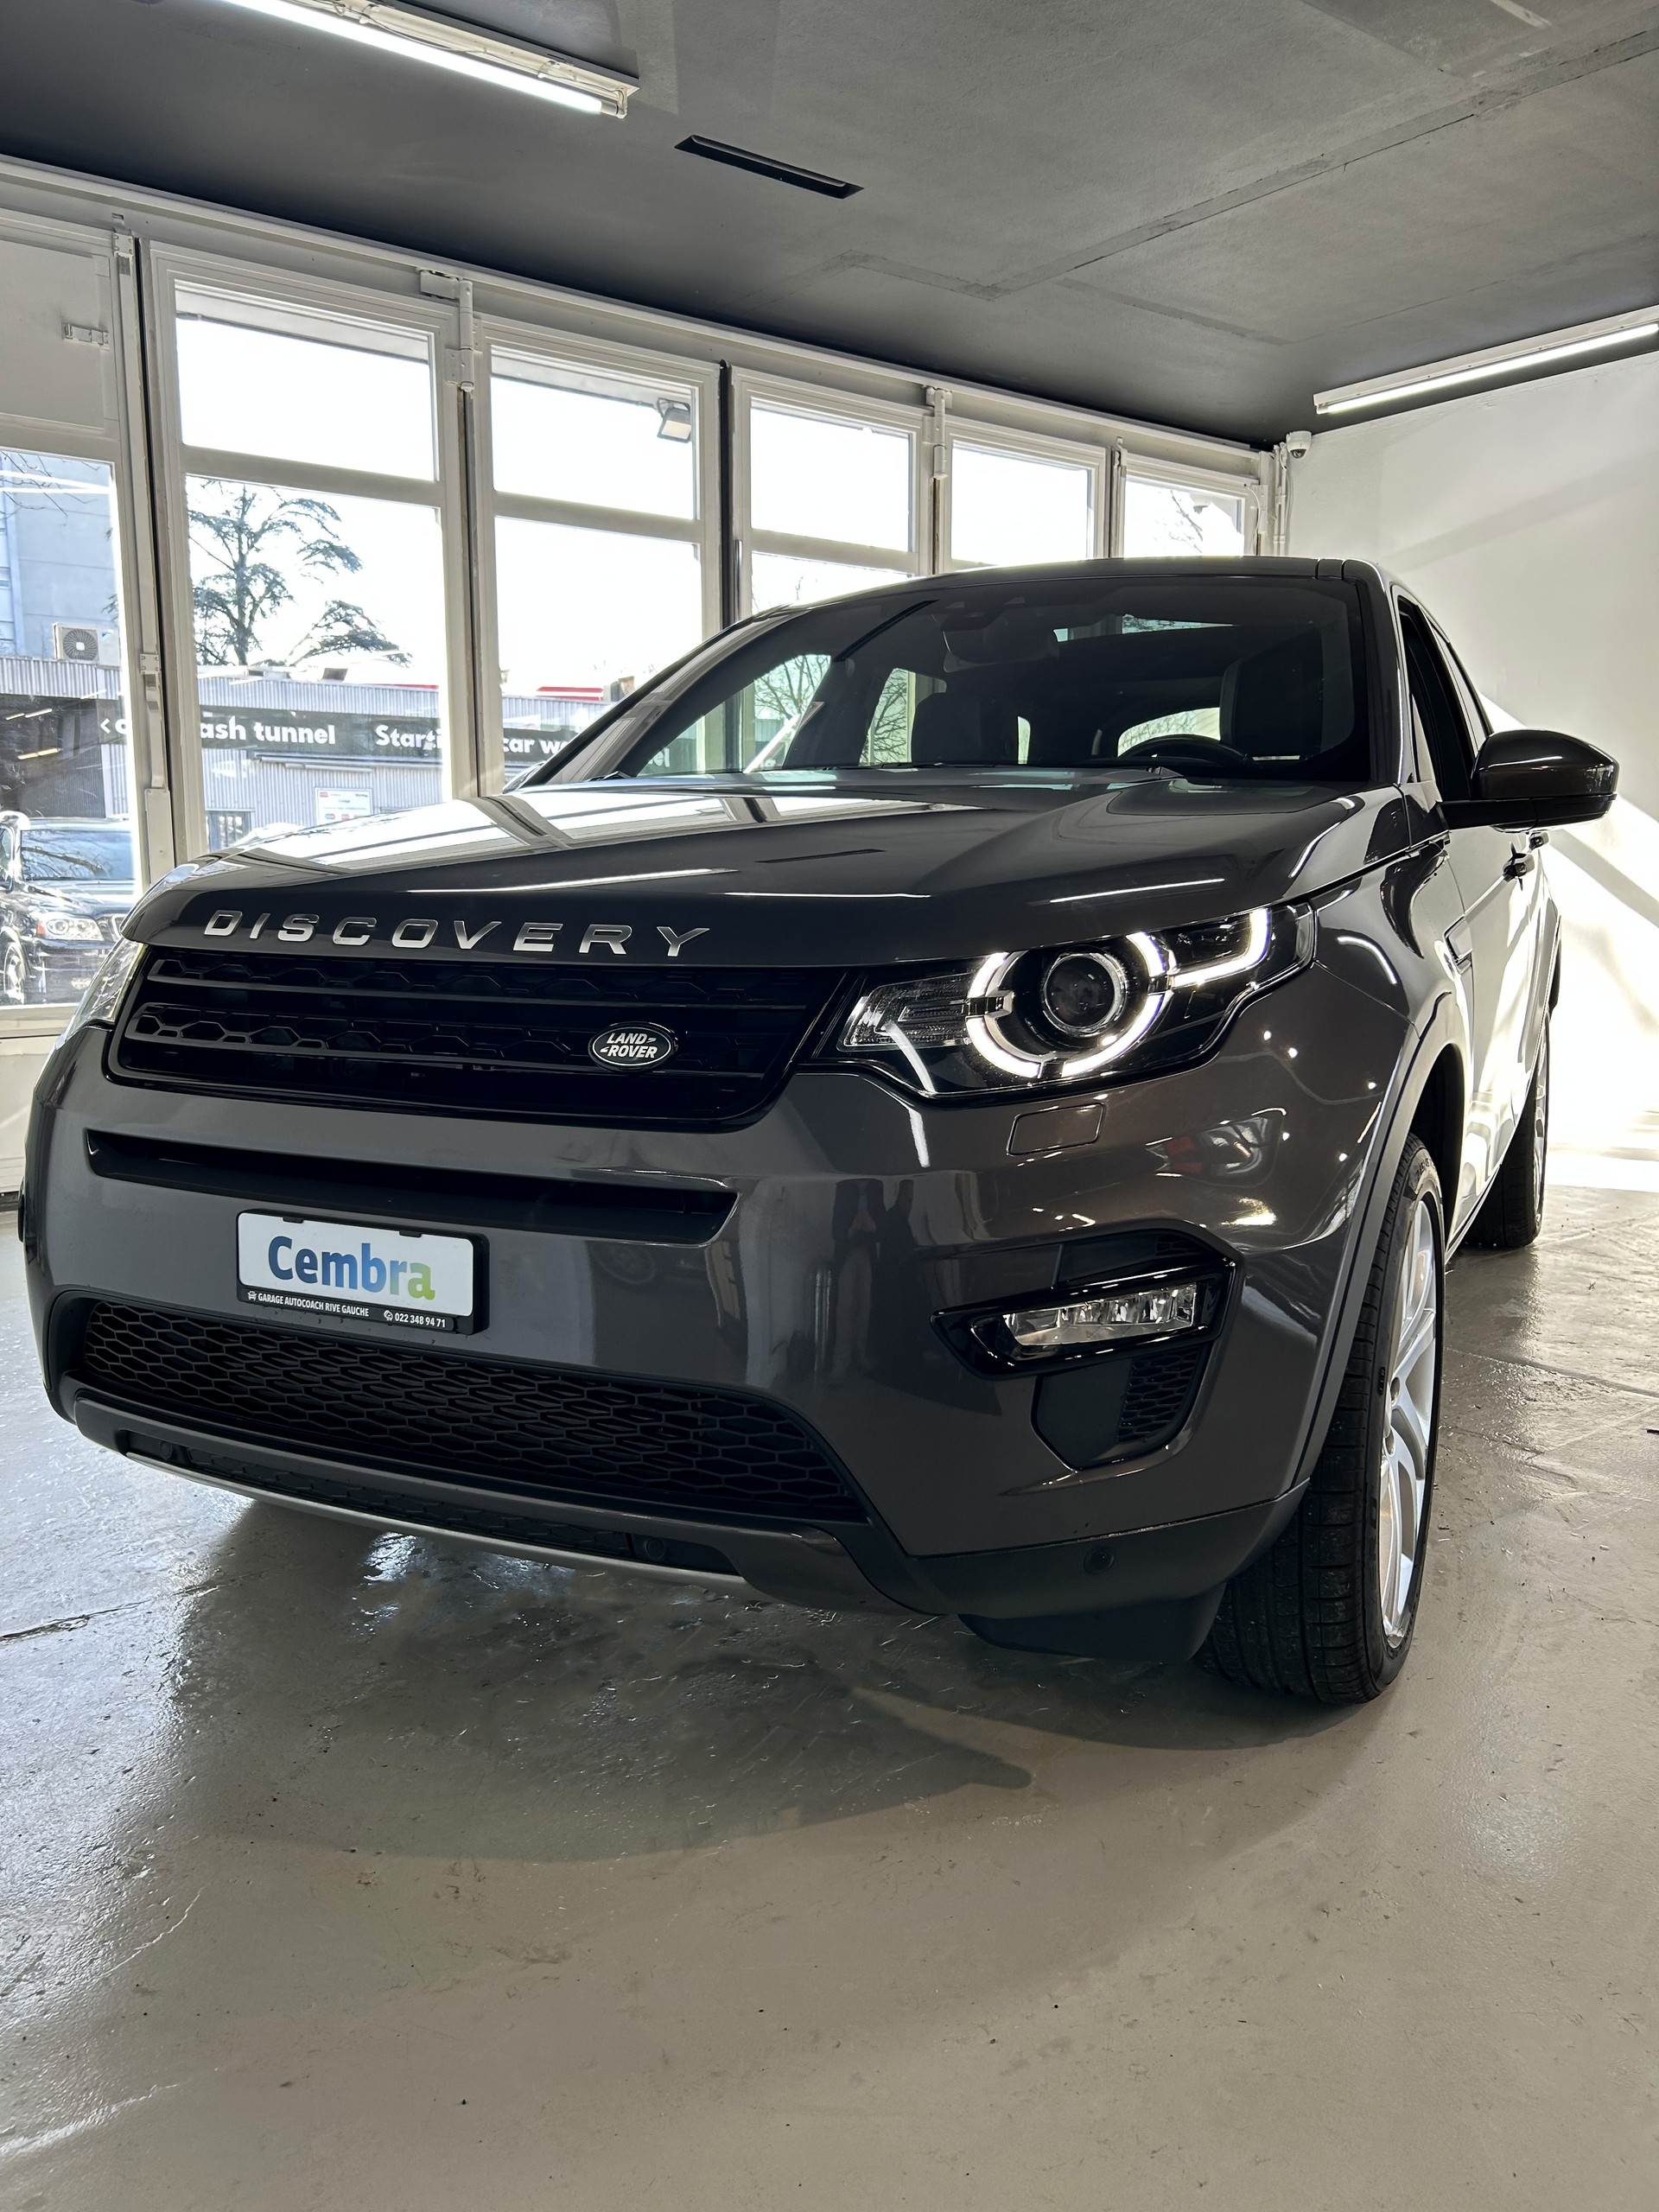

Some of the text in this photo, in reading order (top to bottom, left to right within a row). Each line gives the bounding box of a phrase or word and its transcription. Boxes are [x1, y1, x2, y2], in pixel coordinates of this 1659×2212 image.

[200, 715, 335, 745] ash tunnel
[375, 724, 442, 749] Starti
[204, 909, 709, 957] DISCOVERY
[607, 1045, 658, 1058] ROVER
[268, 1236, 435, 1300] Cembra
[257, 1293, 446, 1328] GARAGE AUTOCOACH RIVE GAUCHE 022 348 94 71
